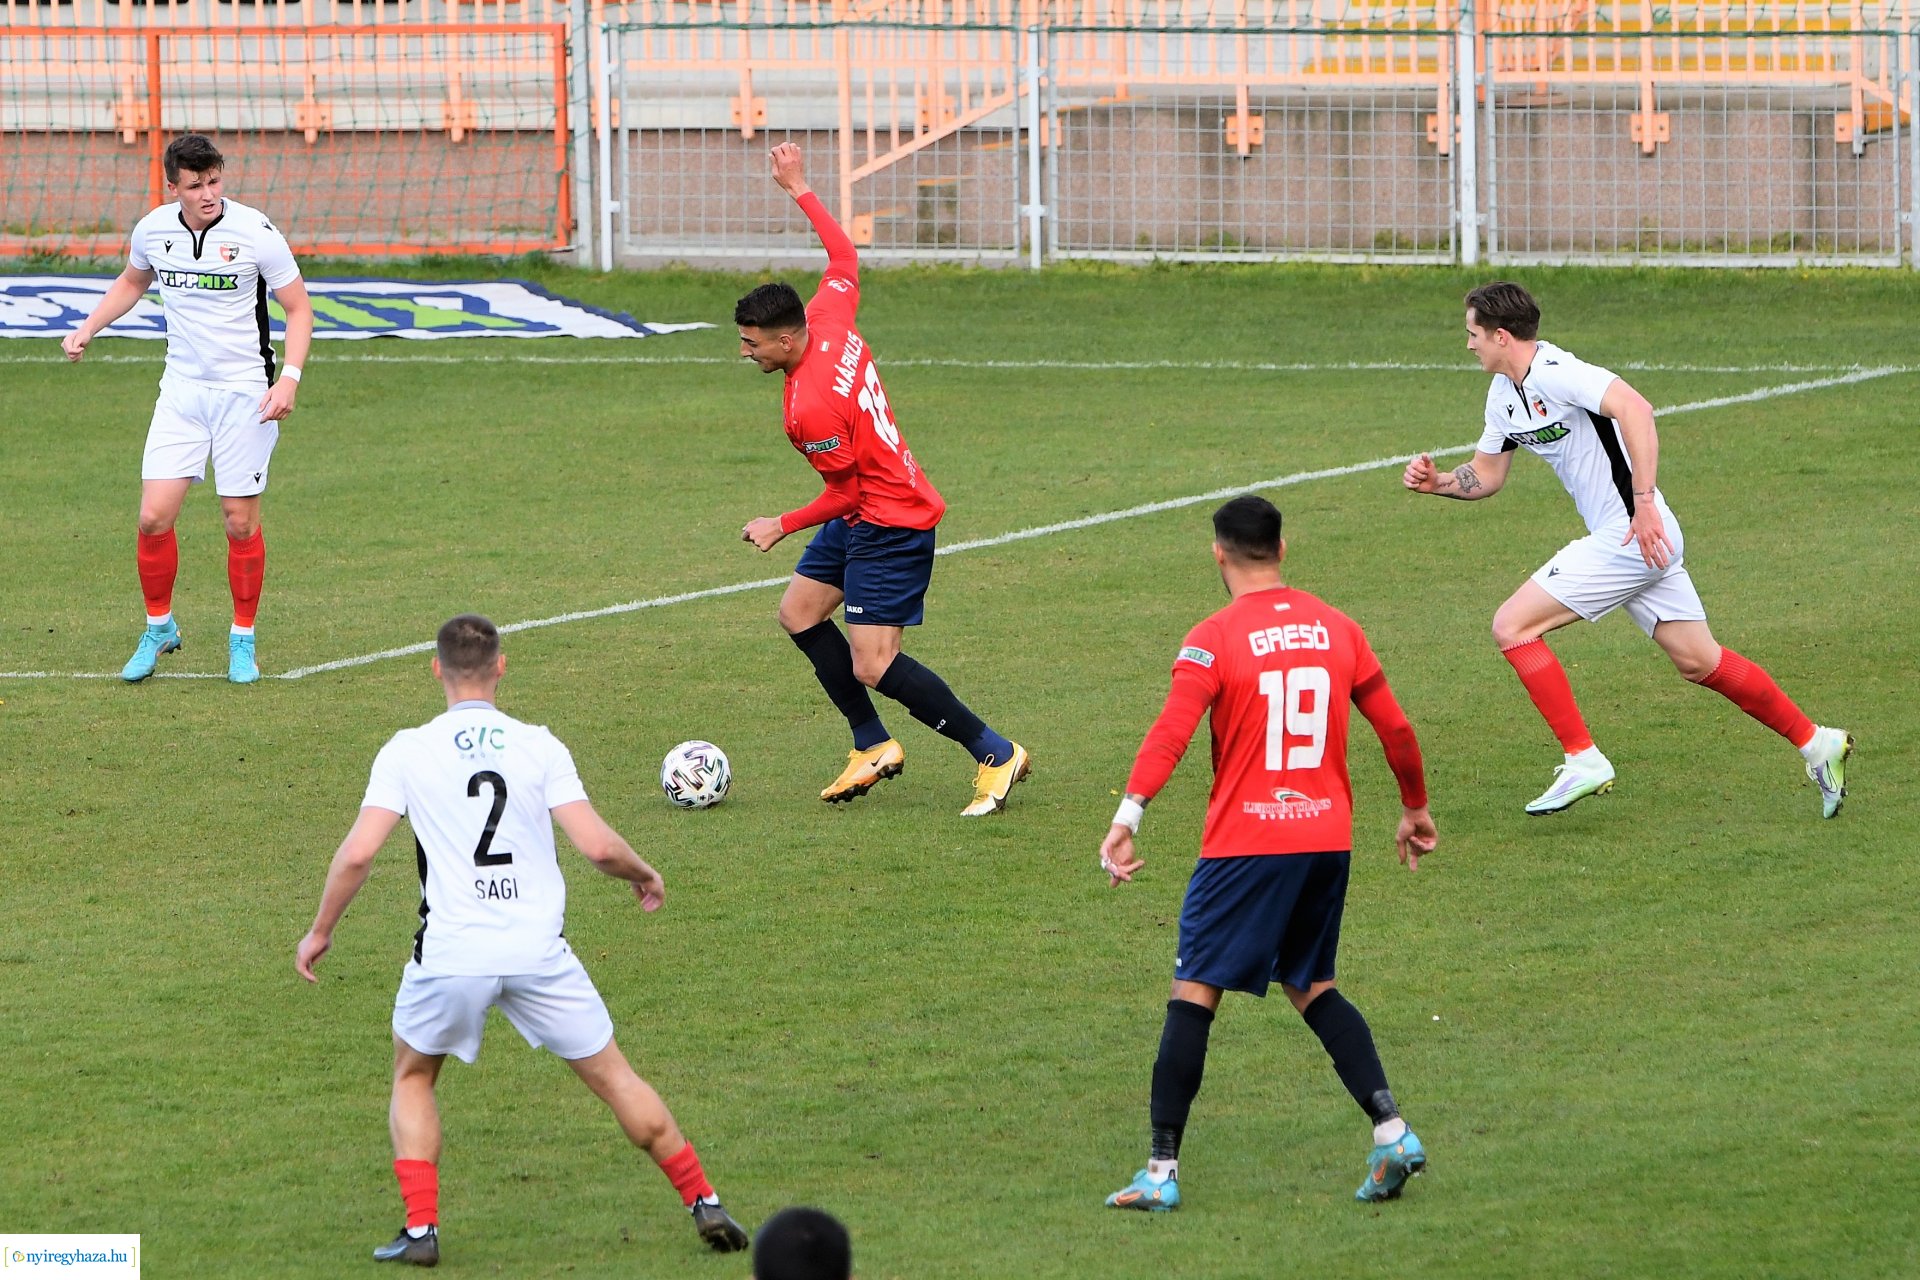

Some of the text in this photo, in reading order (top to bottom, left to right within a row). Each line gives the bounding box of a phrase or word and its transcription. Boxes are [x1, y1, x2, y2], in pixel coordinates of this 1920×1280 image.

[832, 330, 864, 398] MÁRKUS
[857, 360, 900, 454] 18
[1248, 619, 1330, 657] GRESÓ
[1259, 666, 1331, 771] 19
[467, 770, 513, 867] 2
[474, 873, 519, 900] SÁGI
